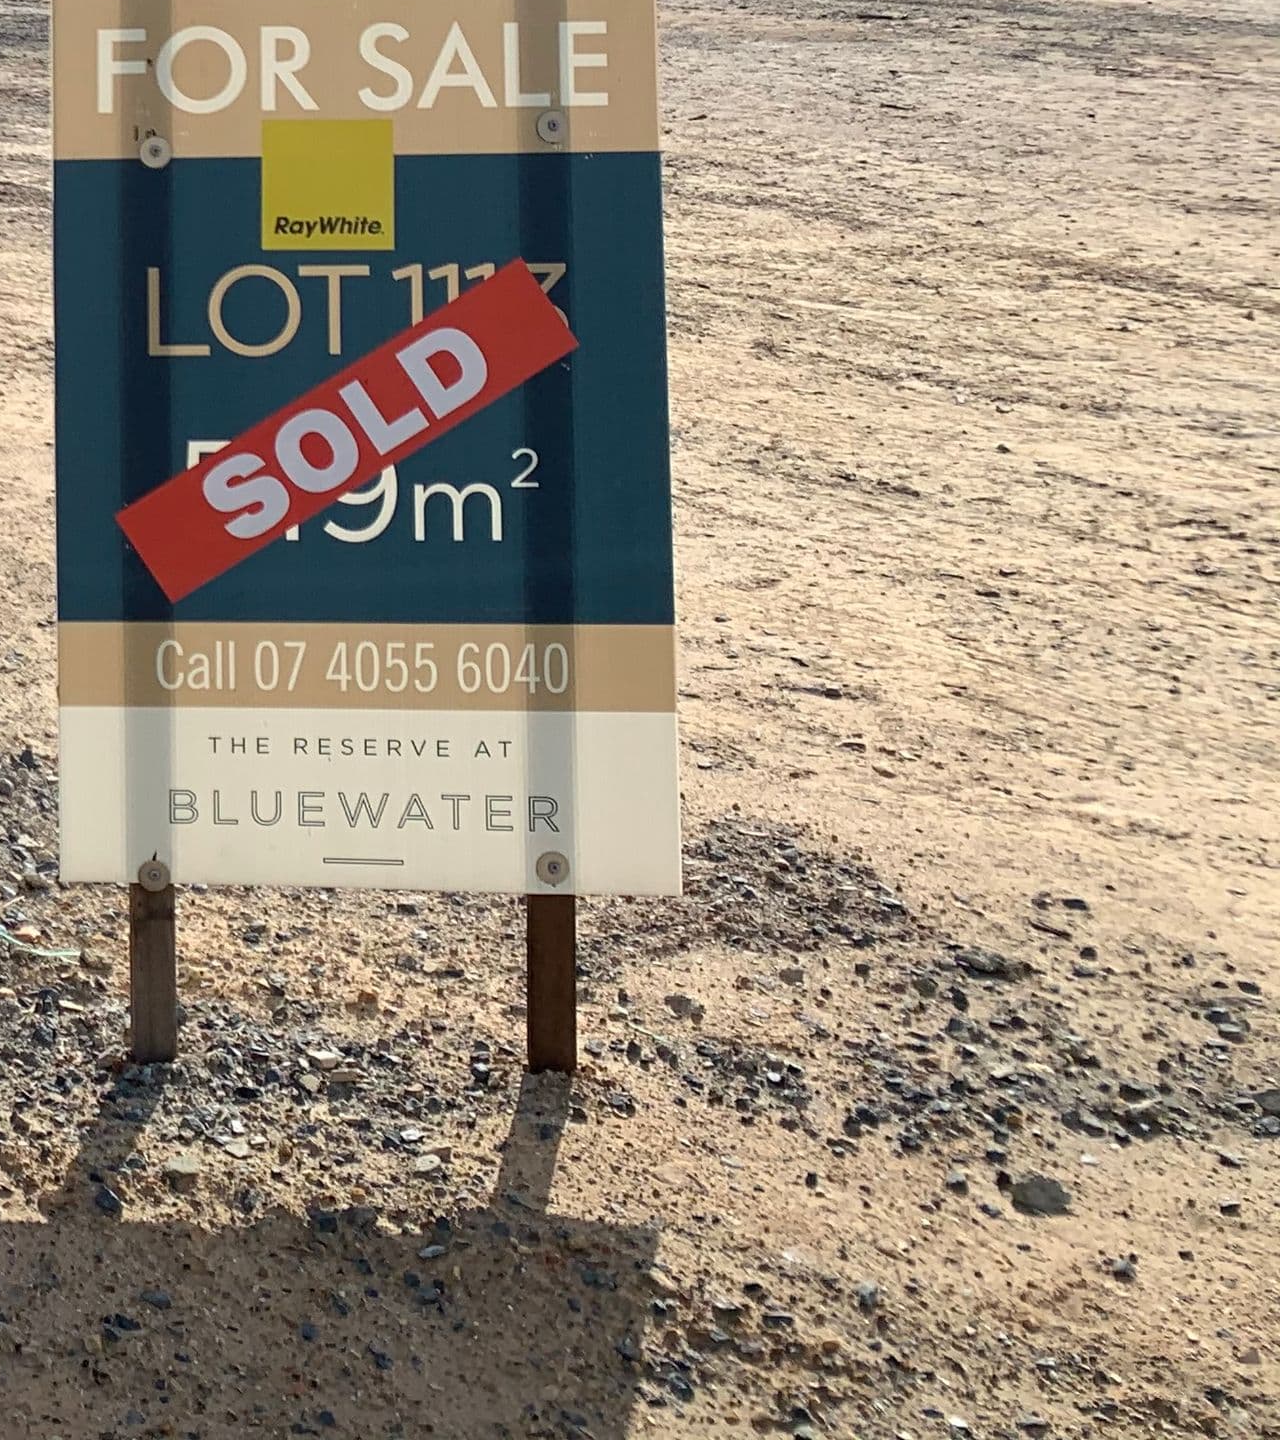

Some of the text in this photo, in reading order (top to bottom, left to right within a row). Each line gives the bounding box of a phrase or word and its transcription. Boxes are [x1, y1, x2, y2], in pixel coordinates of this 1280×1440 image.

[96, 21, 610, 115] FOR SALE
[147, 263, 371, 358] LOT
[202, 326, 489, 541] SOLD
[155, 639, 570, 696] Call 07 4055 6040
[208, 735, 514, 759] THE RESERVE AT
[168, 788, 561, 834] BLUEWATER
